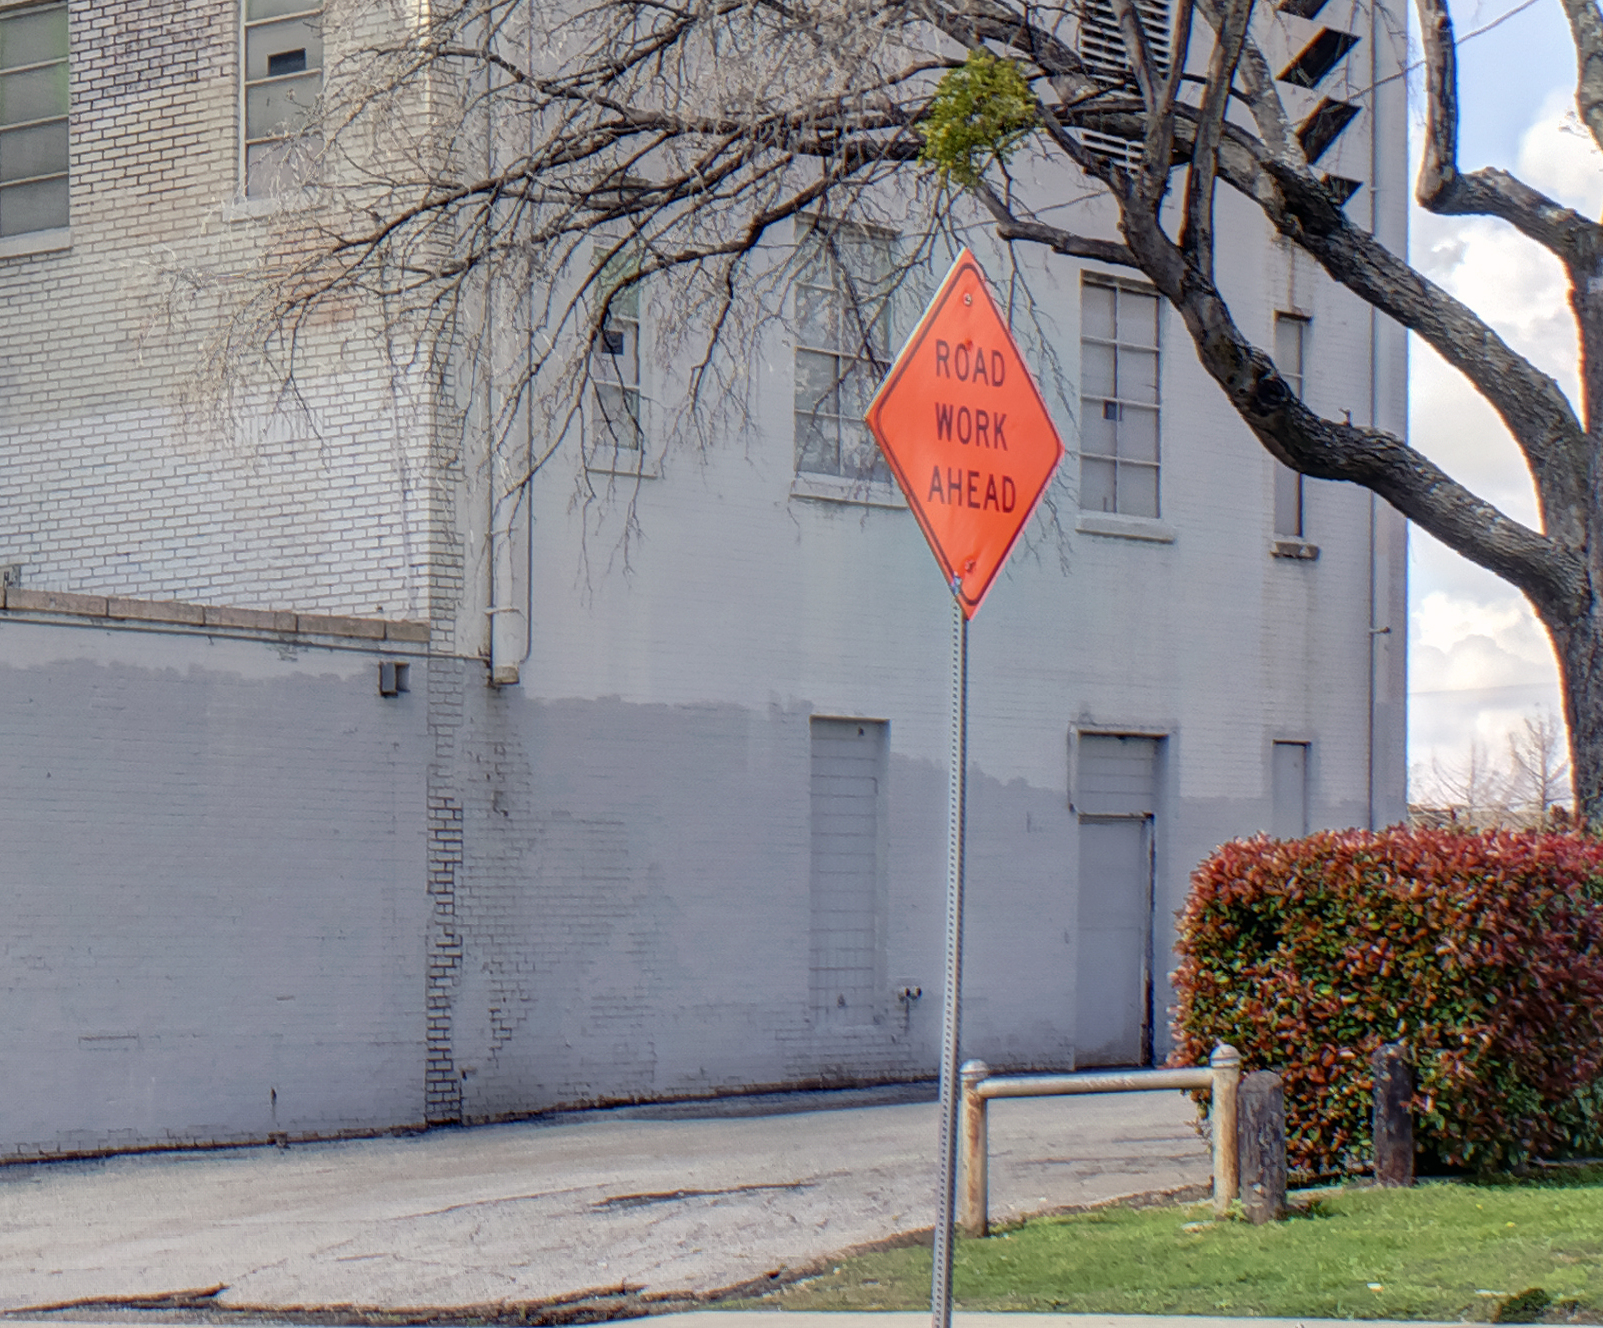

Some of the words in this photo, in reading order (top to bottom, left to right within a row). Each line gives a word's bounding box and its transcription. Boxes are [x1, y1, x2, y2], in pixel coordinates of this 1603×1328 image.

[935, 338, 1006, 388] ROAD
[934, 401, 1009, 452] WORK
[926, 464, 1017, 515] AHEAD
